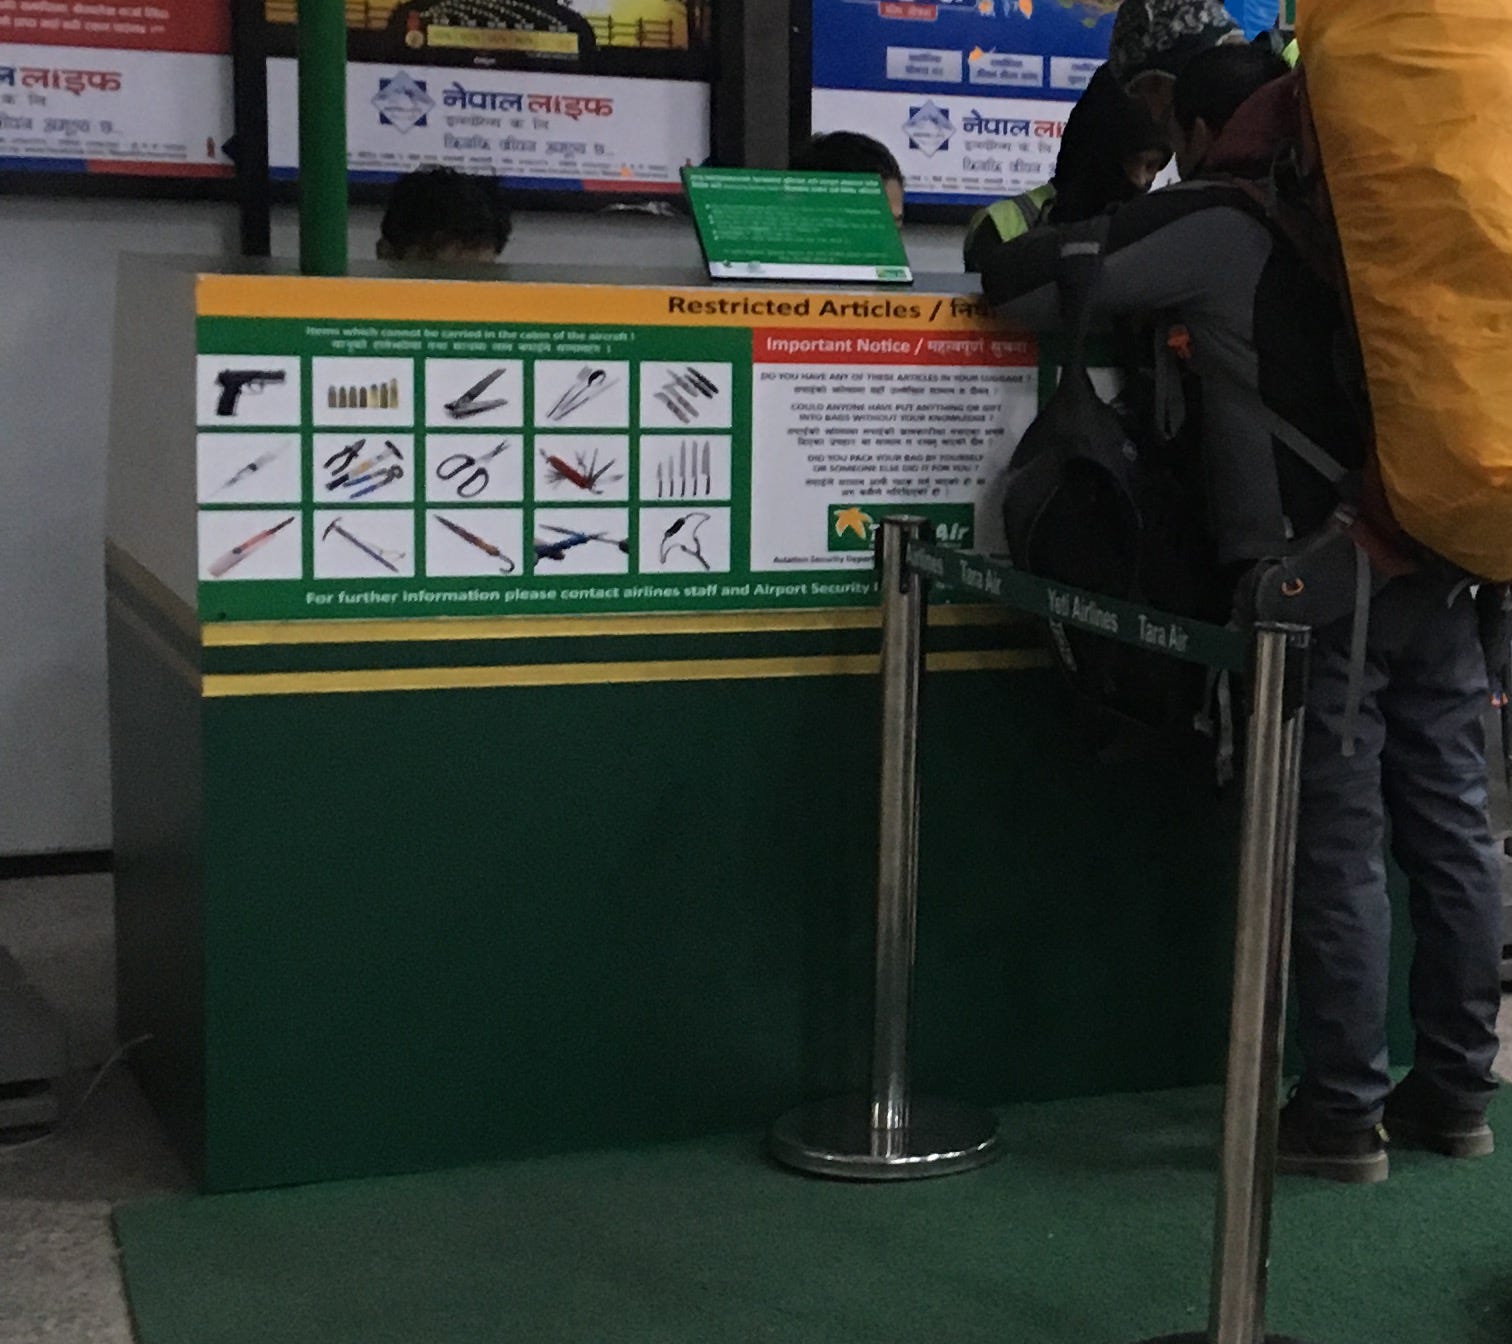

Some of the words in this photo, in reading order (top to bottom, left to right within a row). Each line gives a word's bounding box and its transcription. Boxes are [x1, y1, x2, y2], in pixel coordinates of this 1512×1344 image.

[442, 81, 523, 113] नेपाल
[527, 93, 614, 120] लाइफ
[962, 109, 1030, 137] नेपाल
[668, 296, 810, 317] Restricted
[819, 298, 921, 319] Articles
[766, 337, 851, 354] Important
[857, 338, 911, 354] Notice
[306, 592, 333, 605] For
[338, 589, 398, 605] further
[403, 588, 500, 603] information
[505, 587, 557, 603] please
[560, 586, 619, 600] contact
[623, 584, 680, 599] airlines
[684, 583, 718, 598] staff
[721, 584, 750, 597] and
[754, 581, 807, 598] Airport
[811, 580, 870, 597] Security
[1047, 587, 1070, 616] Yeti
[1072, 596, 1118, 633] Airlines
[1138, 614, 1166, 644] Tara
[1169, 623, 1188, 653] Air
